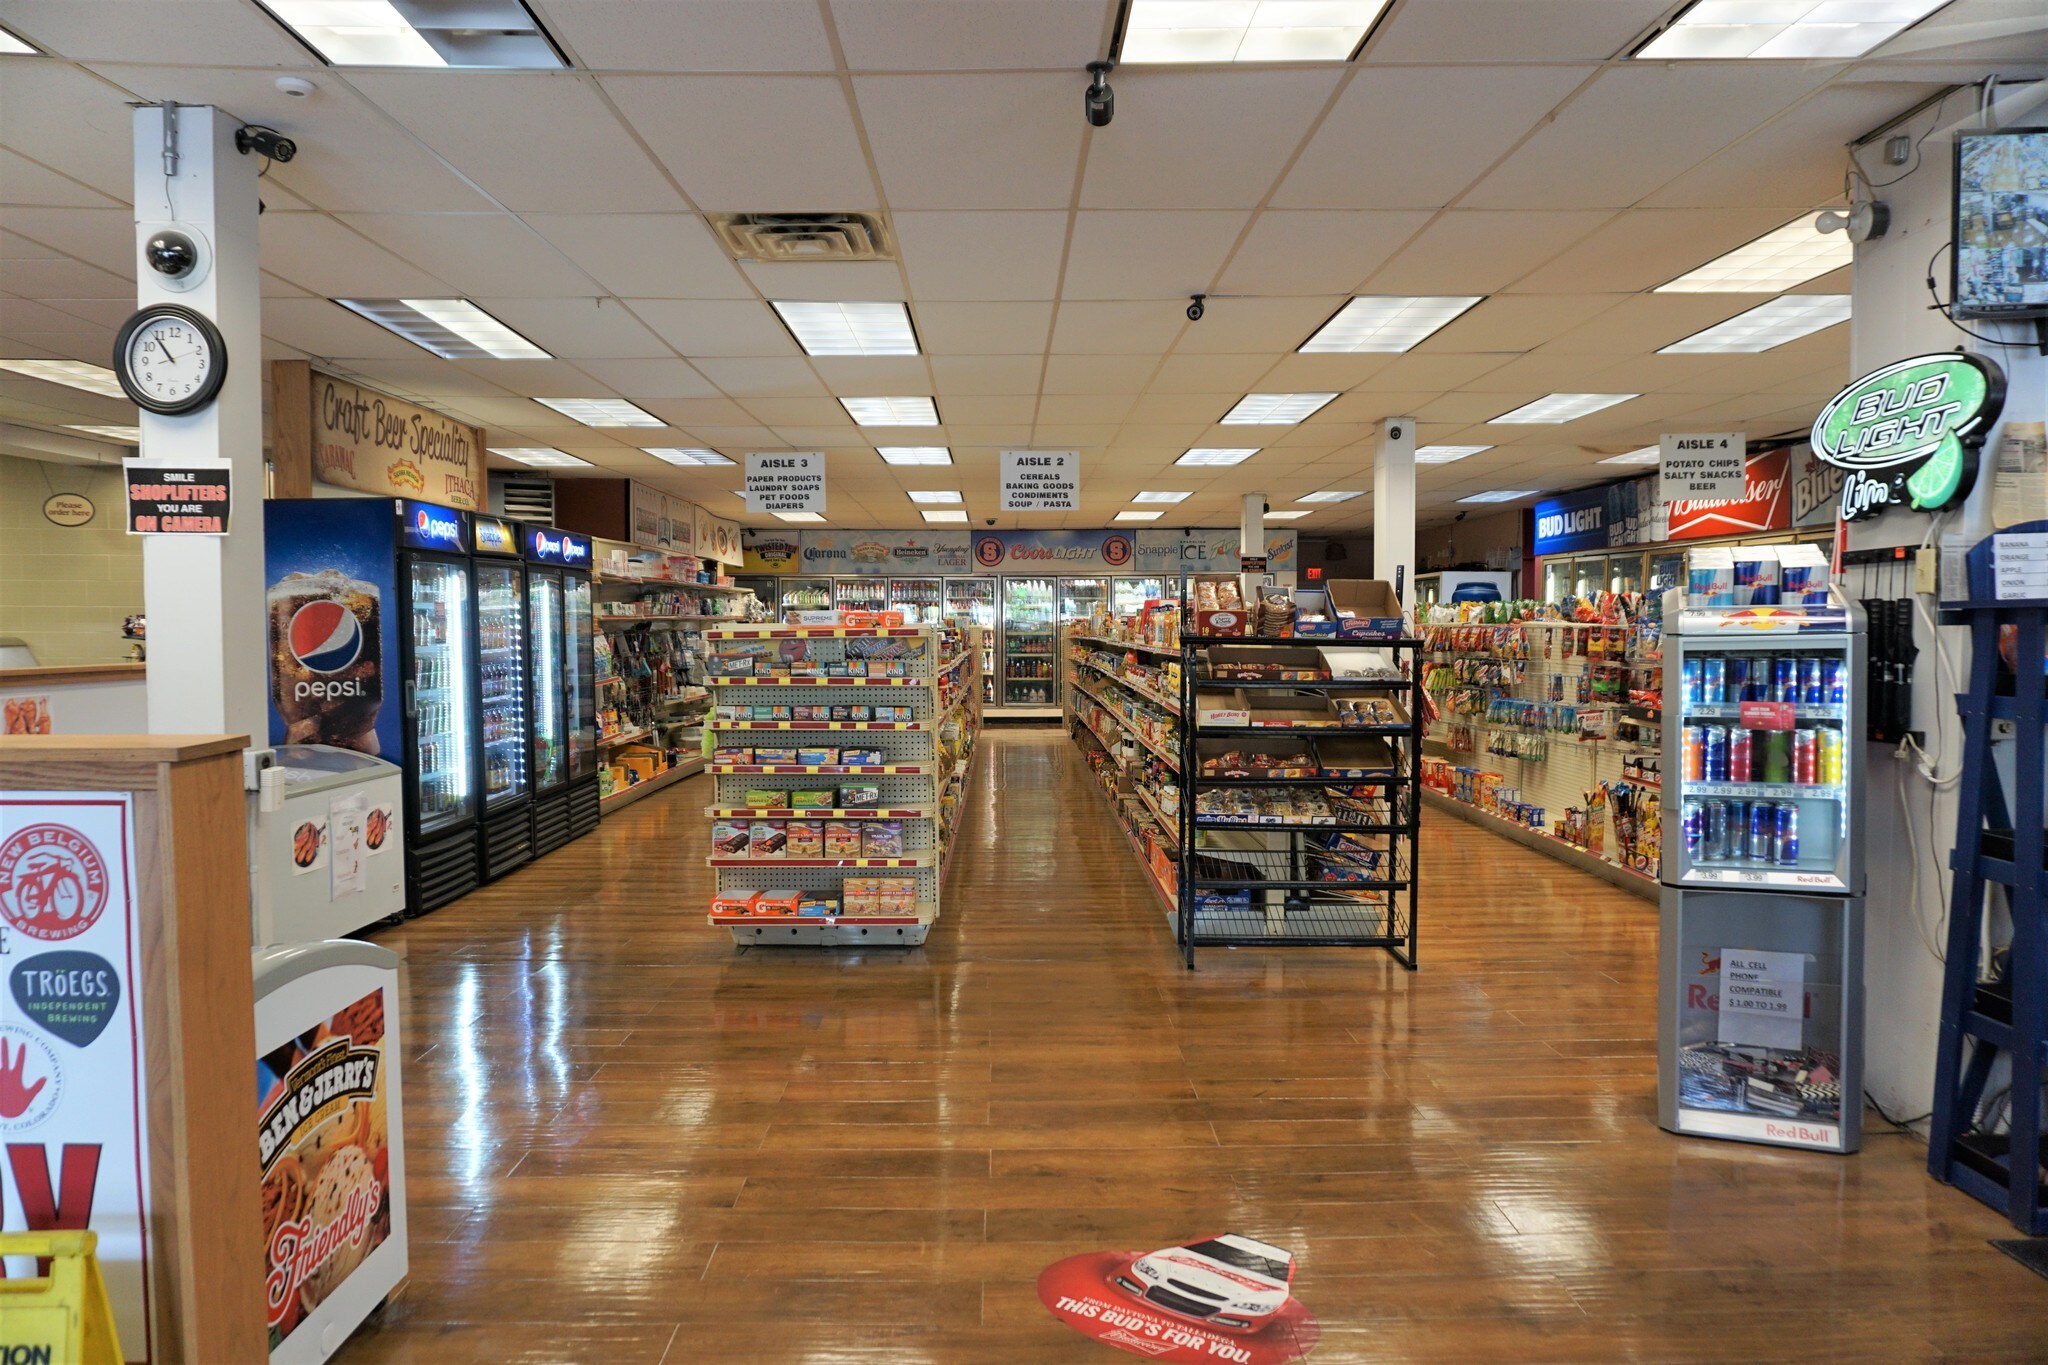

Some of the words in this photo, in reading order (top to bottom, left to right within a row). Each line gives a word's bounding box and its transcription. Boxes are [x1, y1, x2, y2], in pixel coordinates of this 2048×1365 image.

[154, 330, 165, 340] 11
[169, 327, 181, 338] 12
[187, 333, 192, 344] 1
[144, 341, 156, 352] 10
[196, 345, 202, 356] 2
[141, 356, 149, 366] 9
[198, 359, 205, 369] 3
[146, 372, 152, 382] 8
[194, 375, 200, 383] 4
[156, 382, 163, 392] 7
[169, 386, 176, 396] 6
[184, 384, 191, 393] 5
[1851, 373, 1951, 426] BUD
[323, 382, 370, 445] Craft
[373, 398, 408, 450] Beer
[410, 414, 470, 477] Speciality
[1833, 401, 1962, 459] LIGHT
[1677, 439, 1714, 450] AISLE
[1720, 439, 1728, 448] 4
[760, 459, 795, 468] AISLE
[801, 459, 808, 468] 3
[1016, 457, 1051, 466] AISLE
[1056, 457, 1064, 466] 2
[1666, 460, 1704, 468] POTATO
[1708, 459, 1740, 467] CHIPS
[163, 473, 195, 482] SMILE
[1700, 470, 1742, 478] SNACKS
[444, 474, 475, 500] ITHACA
[1690, 482, 1716, 490] BEER
[130, 484, 226, 501] SHOPLIFTERS
[1796, 464, 1844, 521] Blue
[157, 504, 179, 512] YOU
[181, 505, 202, 513] ARE
[135, 515, 158, 531] ON
[162, 516, 222, 532] CAMERA
[1539, 514, 1564, 539] BUD
[1564, 506, 1602, 534] LIGHT
[430, 518, 458, 541] pepsi
[545, 540, 560, 554] pepsi
[571, 545, 585, 558] pepsi
[1010, 543, 1053, 560] Coors
[1052, 547, 1097, 560] LIGHT
[1138, 544, 1178, 557] Snapple
[1180, 544, 1206, 560] ICE
[1267, 540, 1294, 560] Sunkist
[804, 546, 846, 562] Corona
[1308, 568, 1321, 579] EXIT
[1712, 582, 1728, 590] Bull
[294, 677, 362, 702] pepsi
[1773, 788, 1792, 796] 2.99
[1813, 789, 1831, 797] 2.99
[1338, 842, 1373, 862] CRUNCH
[0, 841, 23, 885] NEW
[28, 831, 102, 885] BELGIUM
[16, 918, 89, 940] BREWING
[1730, 960, 1745, 968] ALL
[1748, 961, 1767, 970] CELL
[1730, 973, 1759, 981] PHONE
[21, 968, 109, 998] TRÖEGS
[1729, 985, 1782, 998] COMPATIBLE
[28, 1002, 108, 1010] INDEPENDENT
[1736, 999, 1754, 1008] 1.00
[1756, 1000, 1768, 1009] TO
[47, 1014, 98, 1023] BREWING
[259, 1094, 300, 1164] BEN
[299, 1084, 314, 1118] &
[313, 1056, 375, 1106] JERRY'S
[1766, 1124, 1796, 1138] Red
[1800, 1128, 1829, 1142] Bull
[266, 1180, 381, 1327] Friendly's
[1082, 1296, 1112, 1310] FROM
[1112, 1305, 1158, 1324] DAYTONA
[1056, 1296, 1100, 1318] THIS
[1099, 1309, 1162, 1336] BUD'S
[1161, 1328, 1206, 1350] FOR
